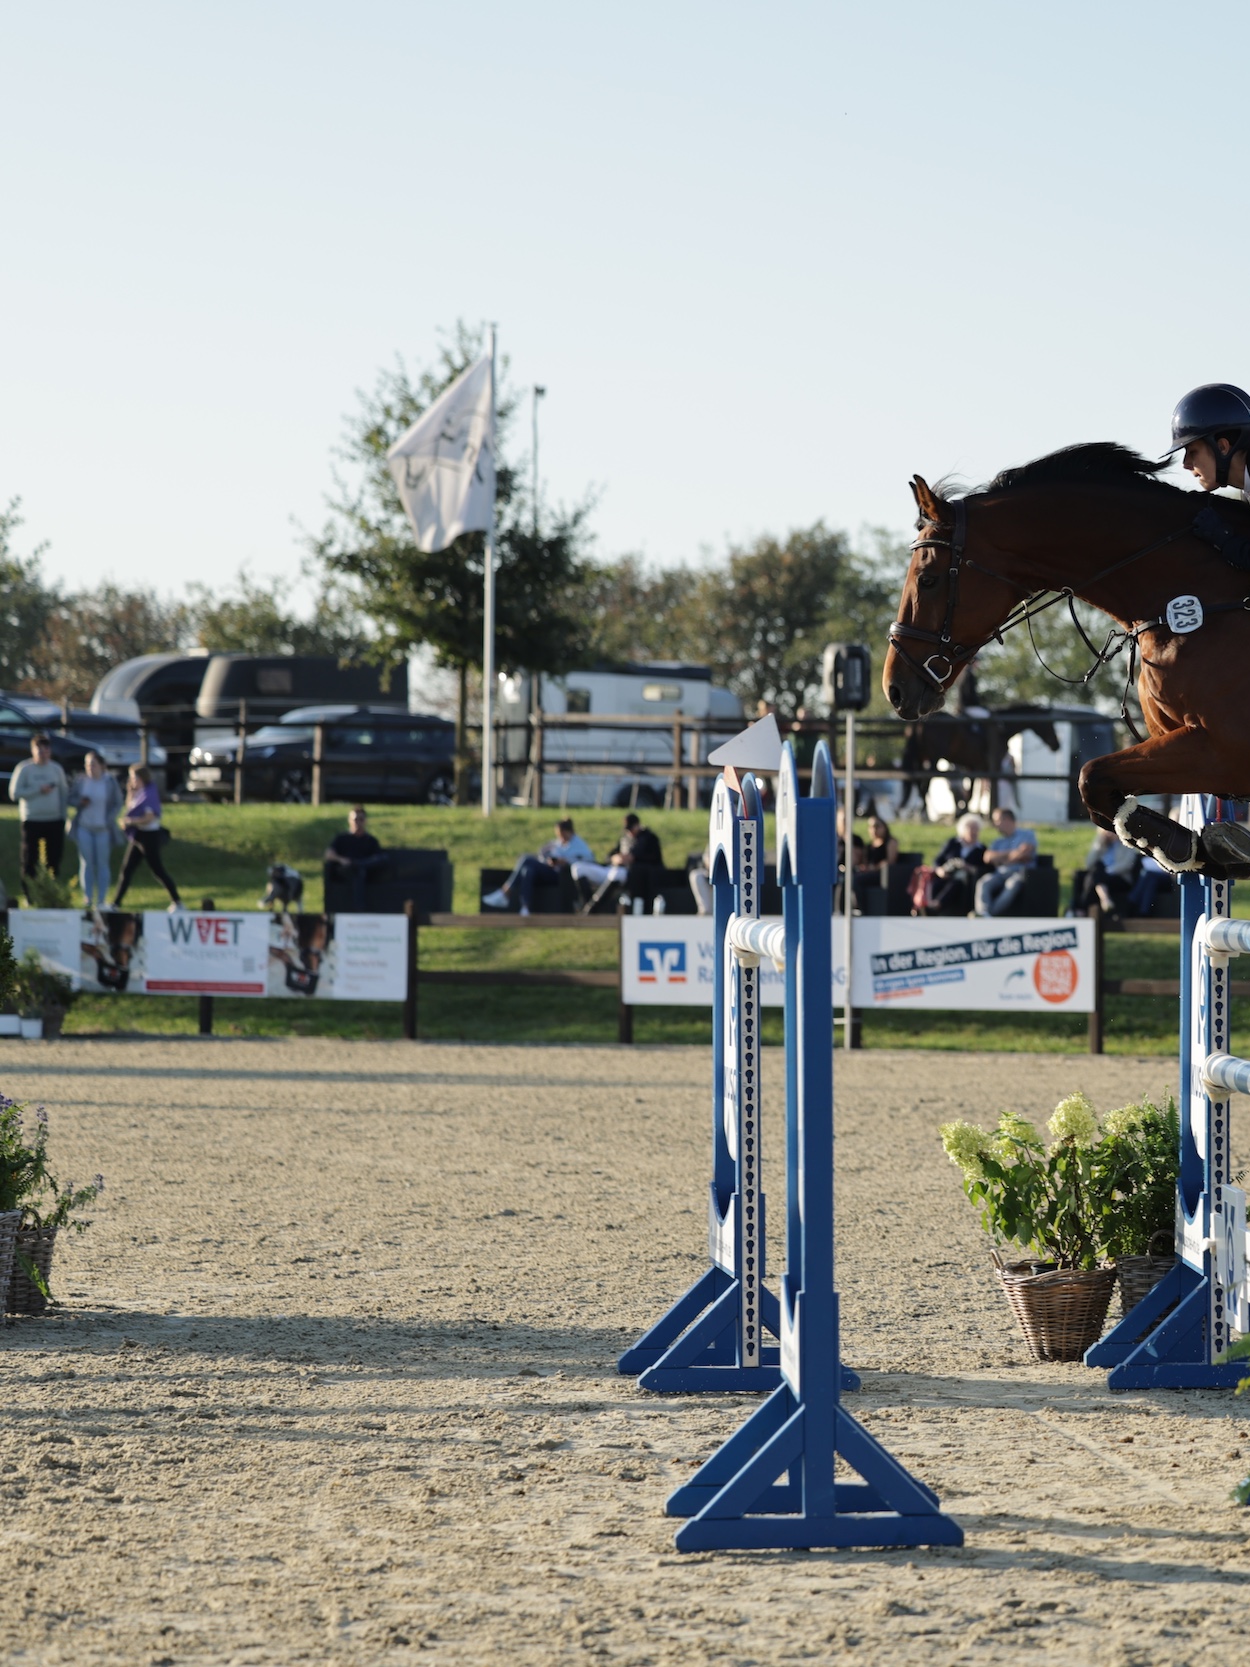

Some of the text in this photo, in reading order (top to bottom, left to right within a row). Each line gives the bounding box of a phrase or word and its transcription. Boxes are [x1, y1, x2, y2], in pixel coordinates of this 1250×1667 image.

[1172, 599, 1199, 629] 323
[873, 929, 1078, 973] In der Region. Für die Region.
